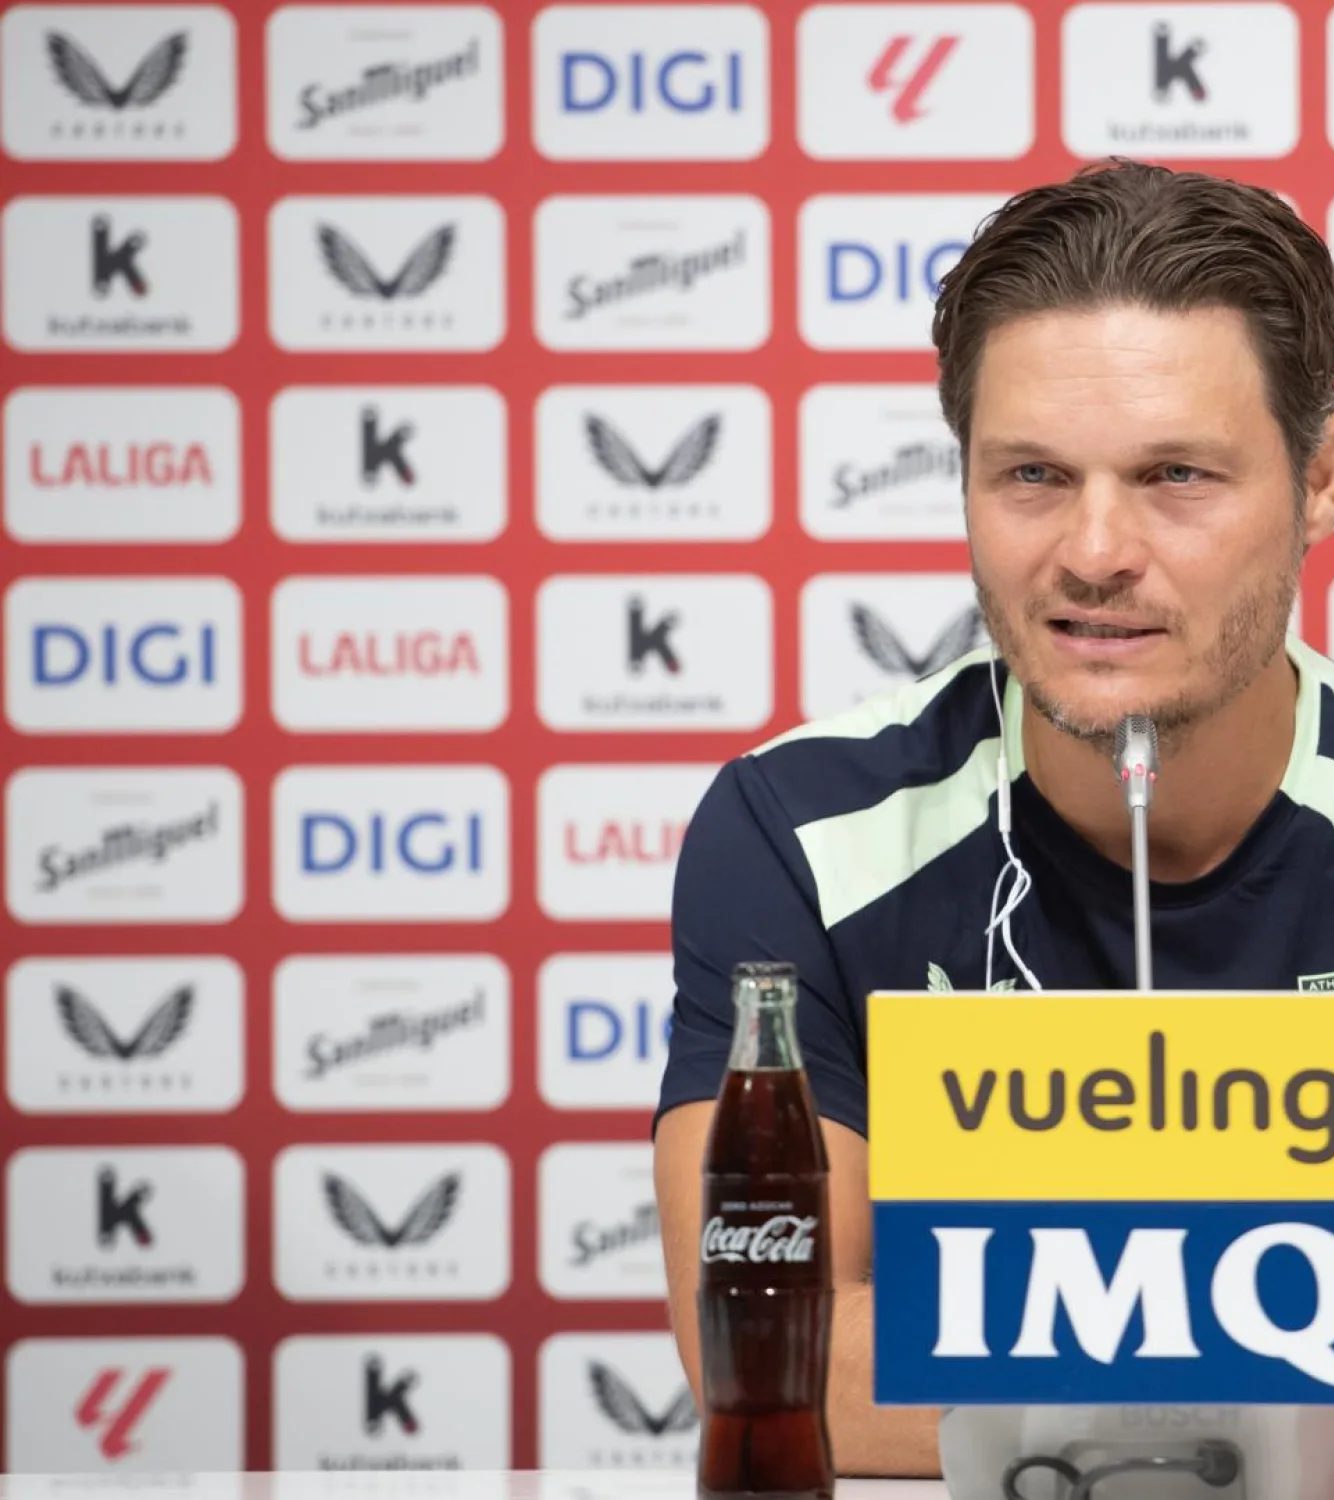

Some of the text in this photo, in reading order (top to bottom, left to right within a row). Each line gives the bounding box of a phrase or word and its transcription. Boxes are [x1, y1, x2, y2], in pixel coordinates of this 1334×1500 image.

[560, 51, 741, 114] DIGI
[828, 242, 968, 302] DI
[29, 442, 212, 488] LALIGA
[32, 624, 215, 687] DIGI
[297, 631, 480, 677] LALIGA
[300, 812, 481, 875] DIGI
[563, 820, 688, 866] LALI
[568, 1001, 672, 1063] DI
